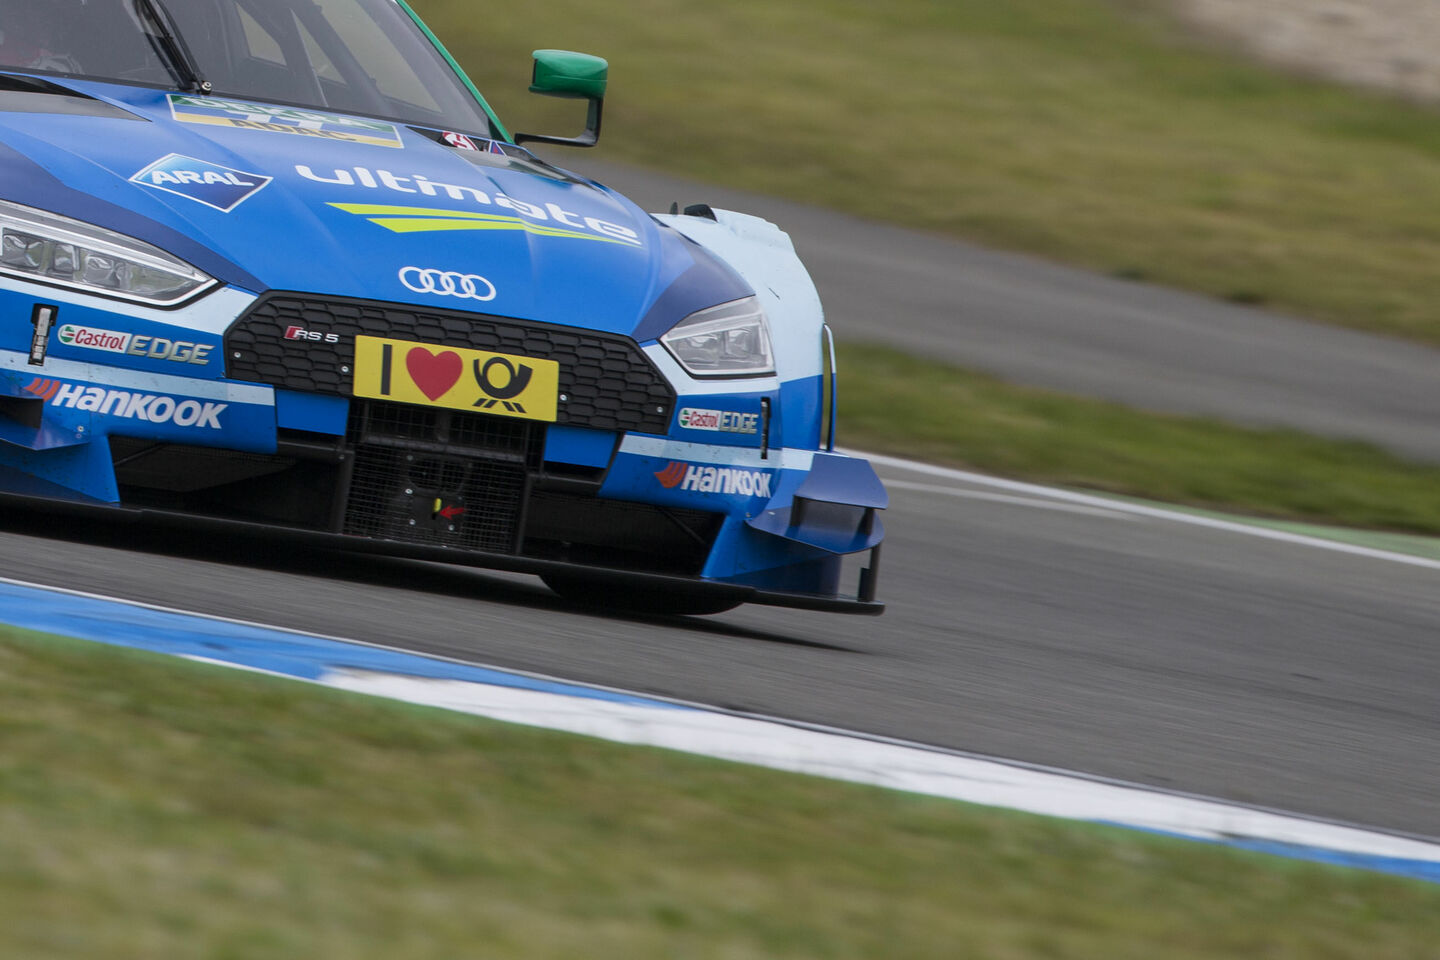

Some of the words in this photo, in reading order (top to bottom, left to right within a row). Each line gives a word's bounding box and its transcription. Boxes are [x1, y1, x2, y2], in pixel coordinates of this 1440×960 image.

[228, 119, 357, 142] ADAC
[151, 170, 255, 188] ARAL
[295, 164, 643, 245] ultimate
[74, 328, 125, 351] Castrol
[126, 334, 215, 365] EDGE
[292, 328, 323, 341] RS
[324, 333, 340, 343] 5
[689, 411, 719, 428] Castrol
[719, 412, 760, 434] EDGE
